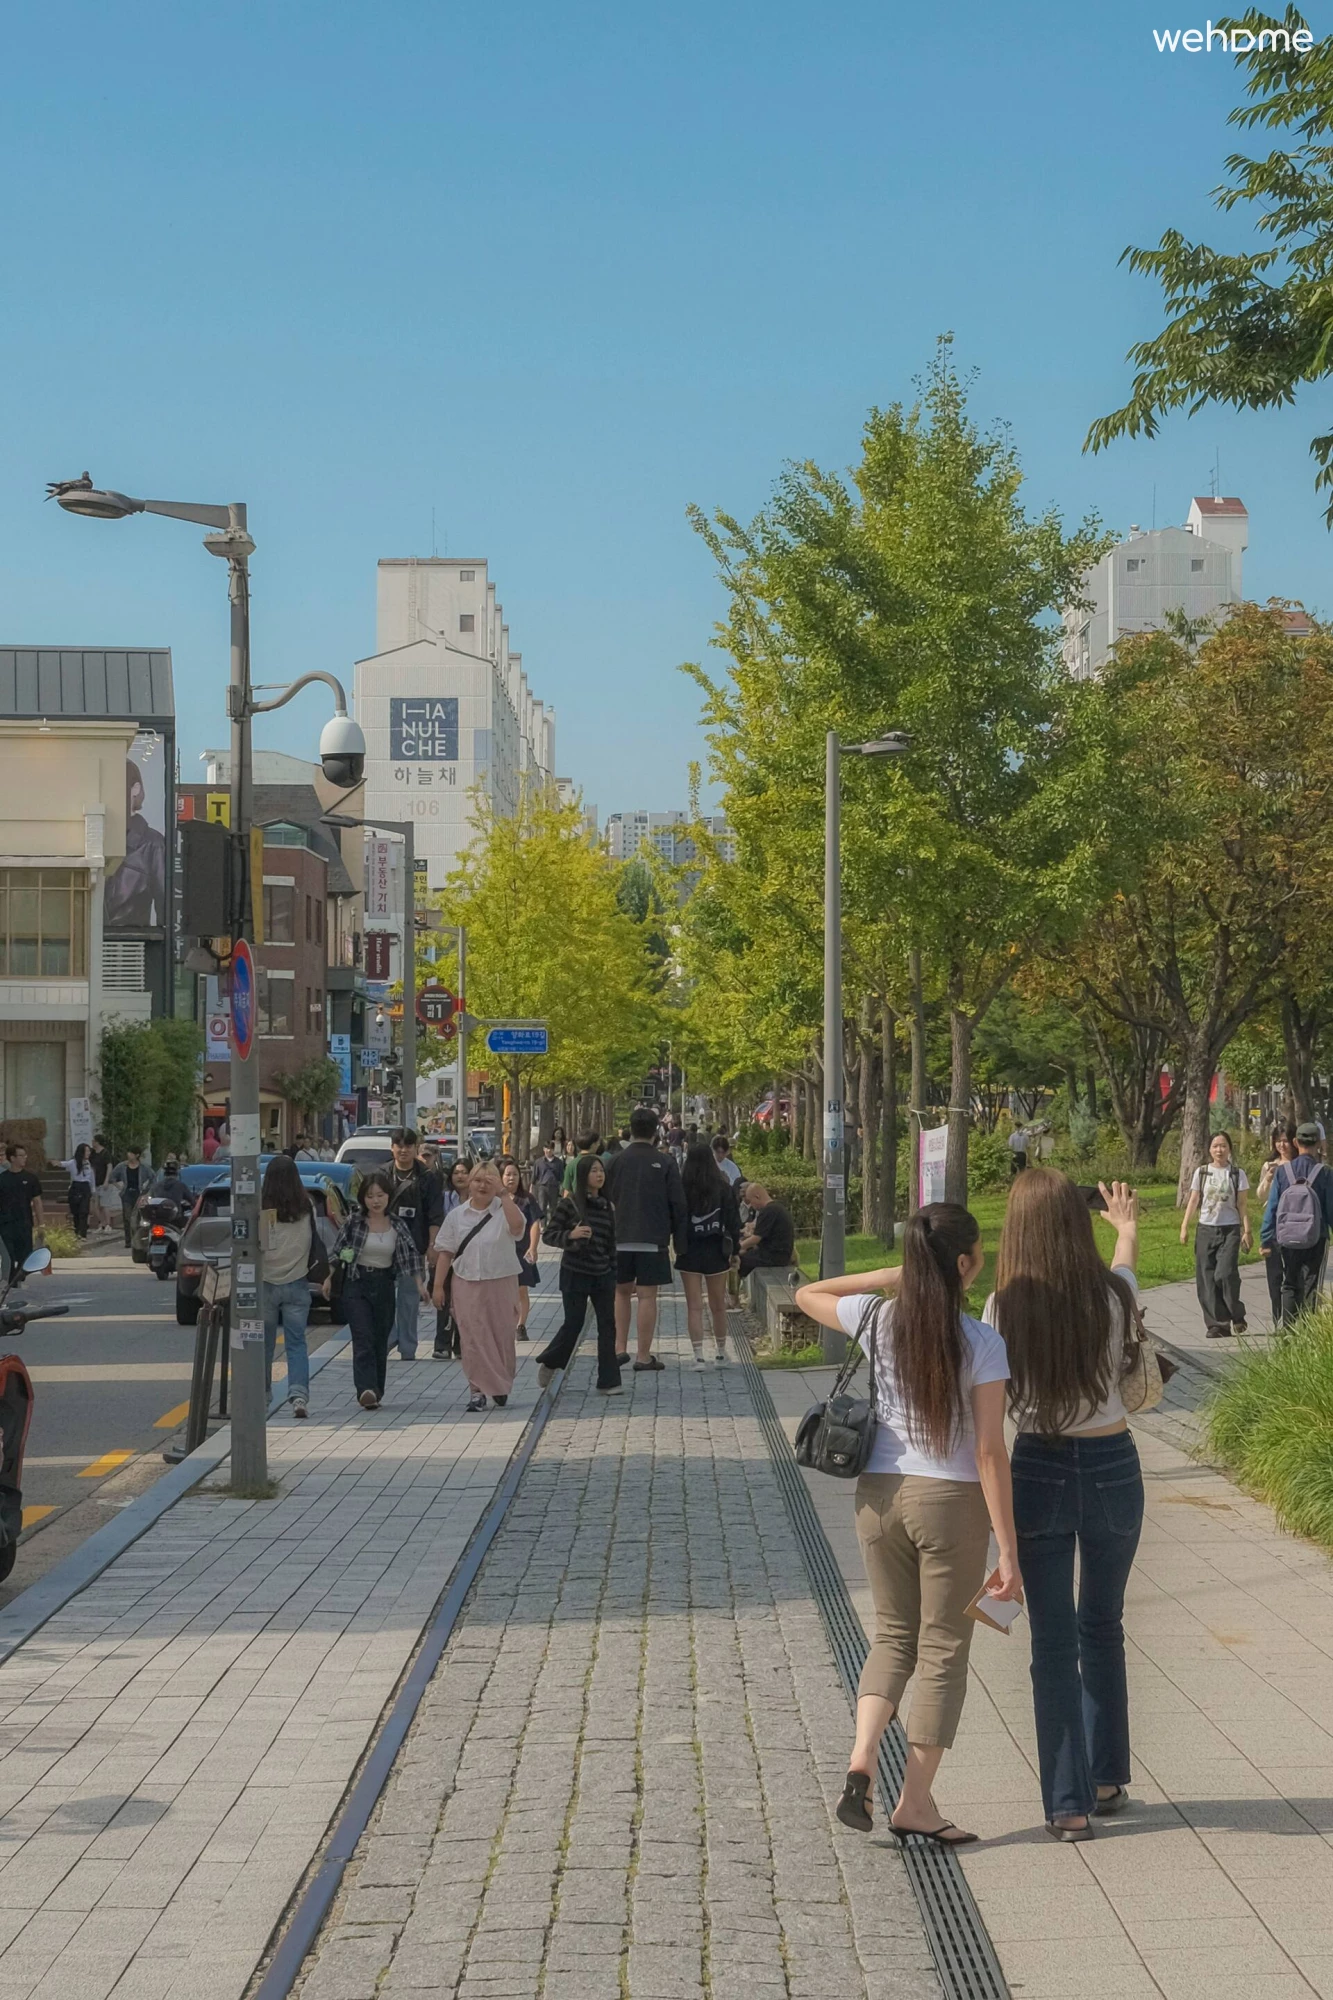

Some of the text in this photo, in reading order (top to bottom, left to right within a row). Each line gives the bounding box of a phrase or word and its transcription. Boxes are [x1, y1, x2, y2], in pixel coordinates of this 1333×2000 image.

[402, 721, 447, 738] NUL
[401, 740, 447, 756] CHE
[394, 767, 456, 785] 하늘채
[406, 800, 440, 816] 106
[377, 856, 388, 889] 부동산
